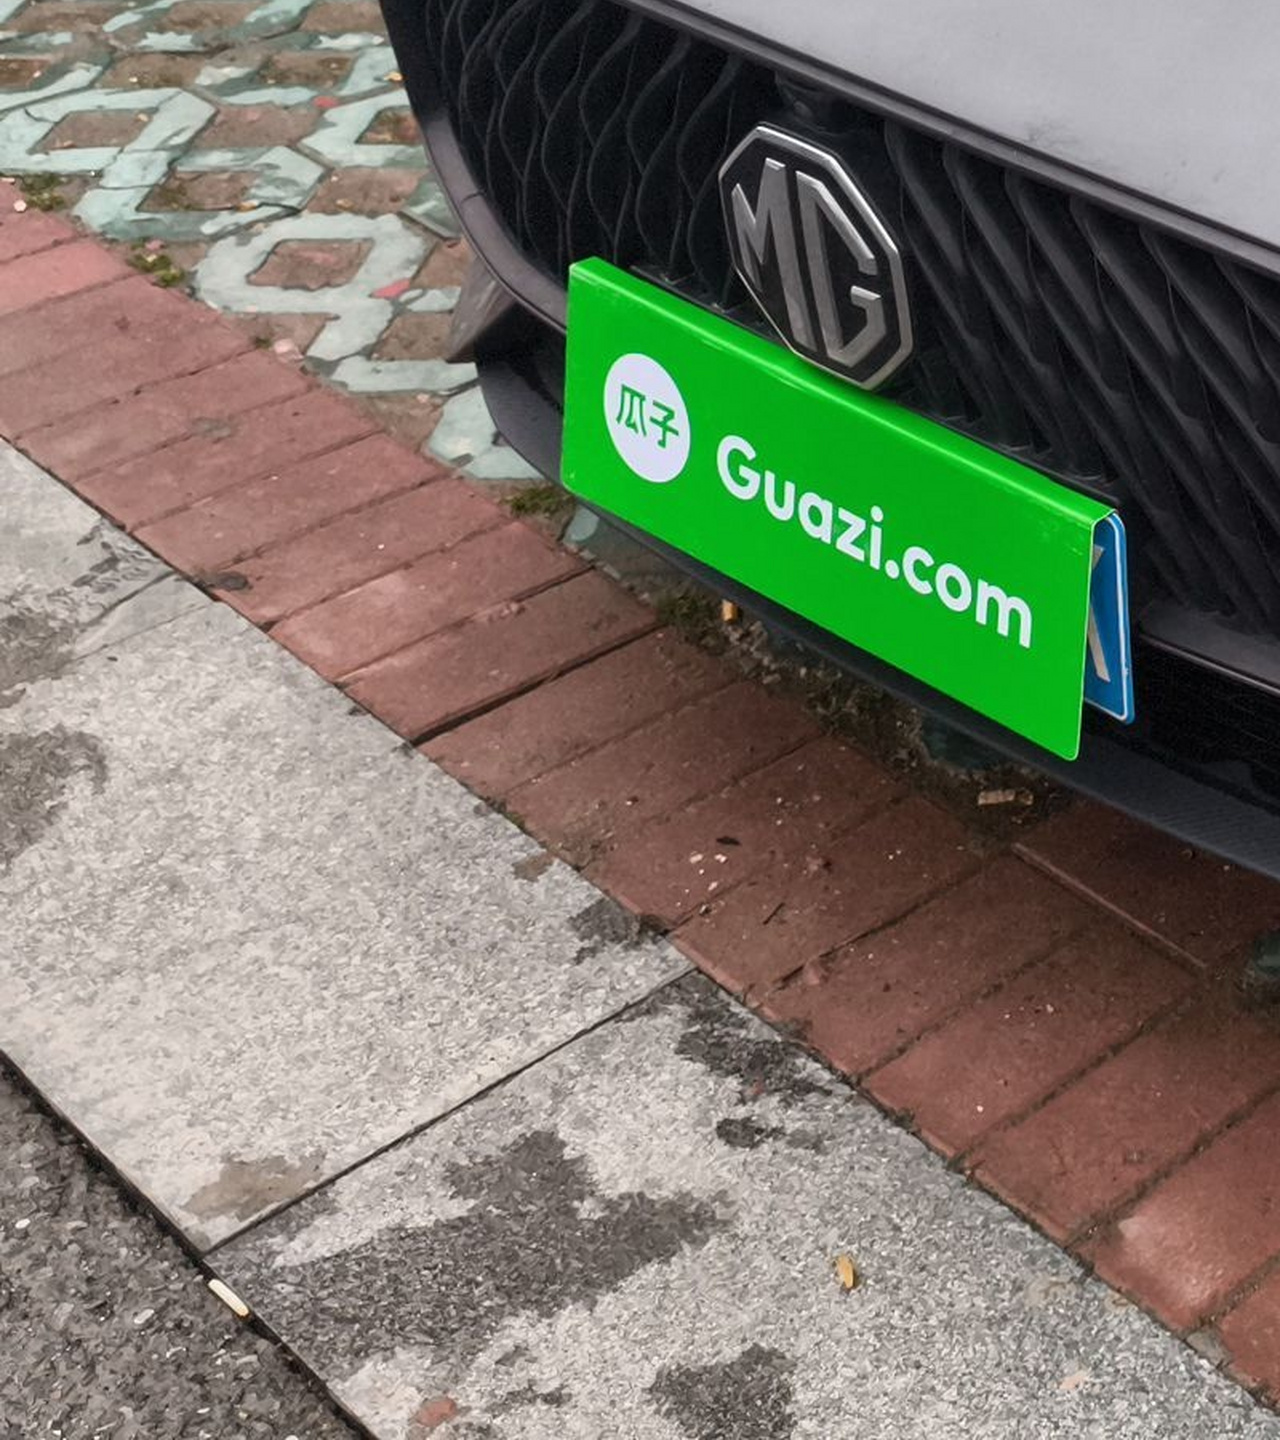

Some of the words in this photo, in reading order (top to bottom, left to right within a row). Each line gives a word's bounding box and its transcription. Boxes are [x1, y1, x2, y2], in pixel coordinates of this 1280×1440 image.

[732, 158, 887, 367] MG
[616, 384, 679, 449] 瓜子
[717, 435, 1032, 648] Guazi.com
